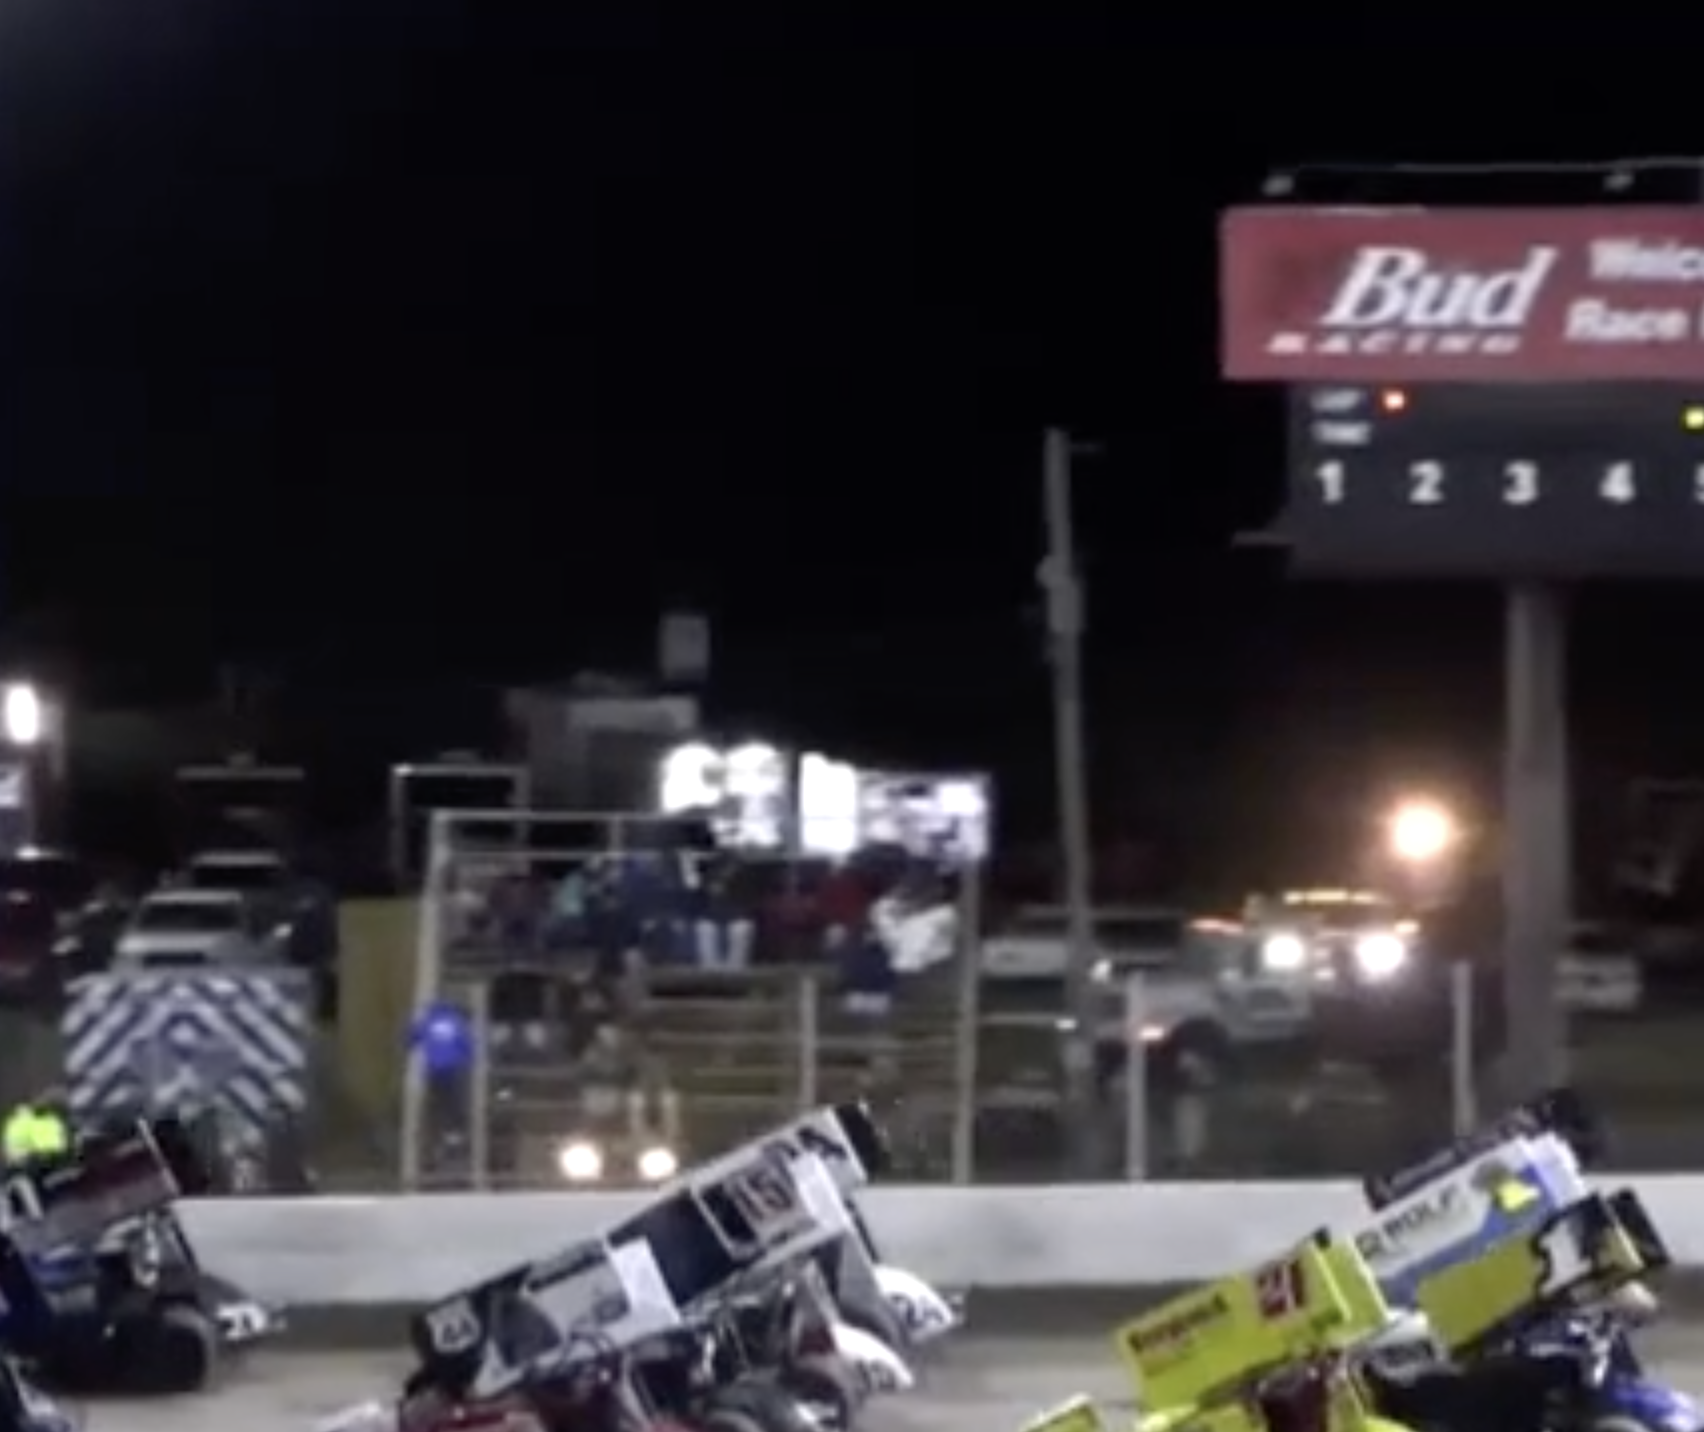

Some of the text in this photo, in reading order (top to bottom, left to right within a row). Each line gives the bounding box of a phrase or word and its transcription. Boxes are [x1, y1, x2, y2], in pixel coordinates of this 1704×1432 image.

[1321, 247, 1559, 328] Bud
[1564, 297, 1690, 341] Race
[1316, 461, 1345, 502] 1
[1410, 461, 1444, 502] 2
[1504, 461, 1538, 502] 3
[1600, 461, 1635, 502] 4
